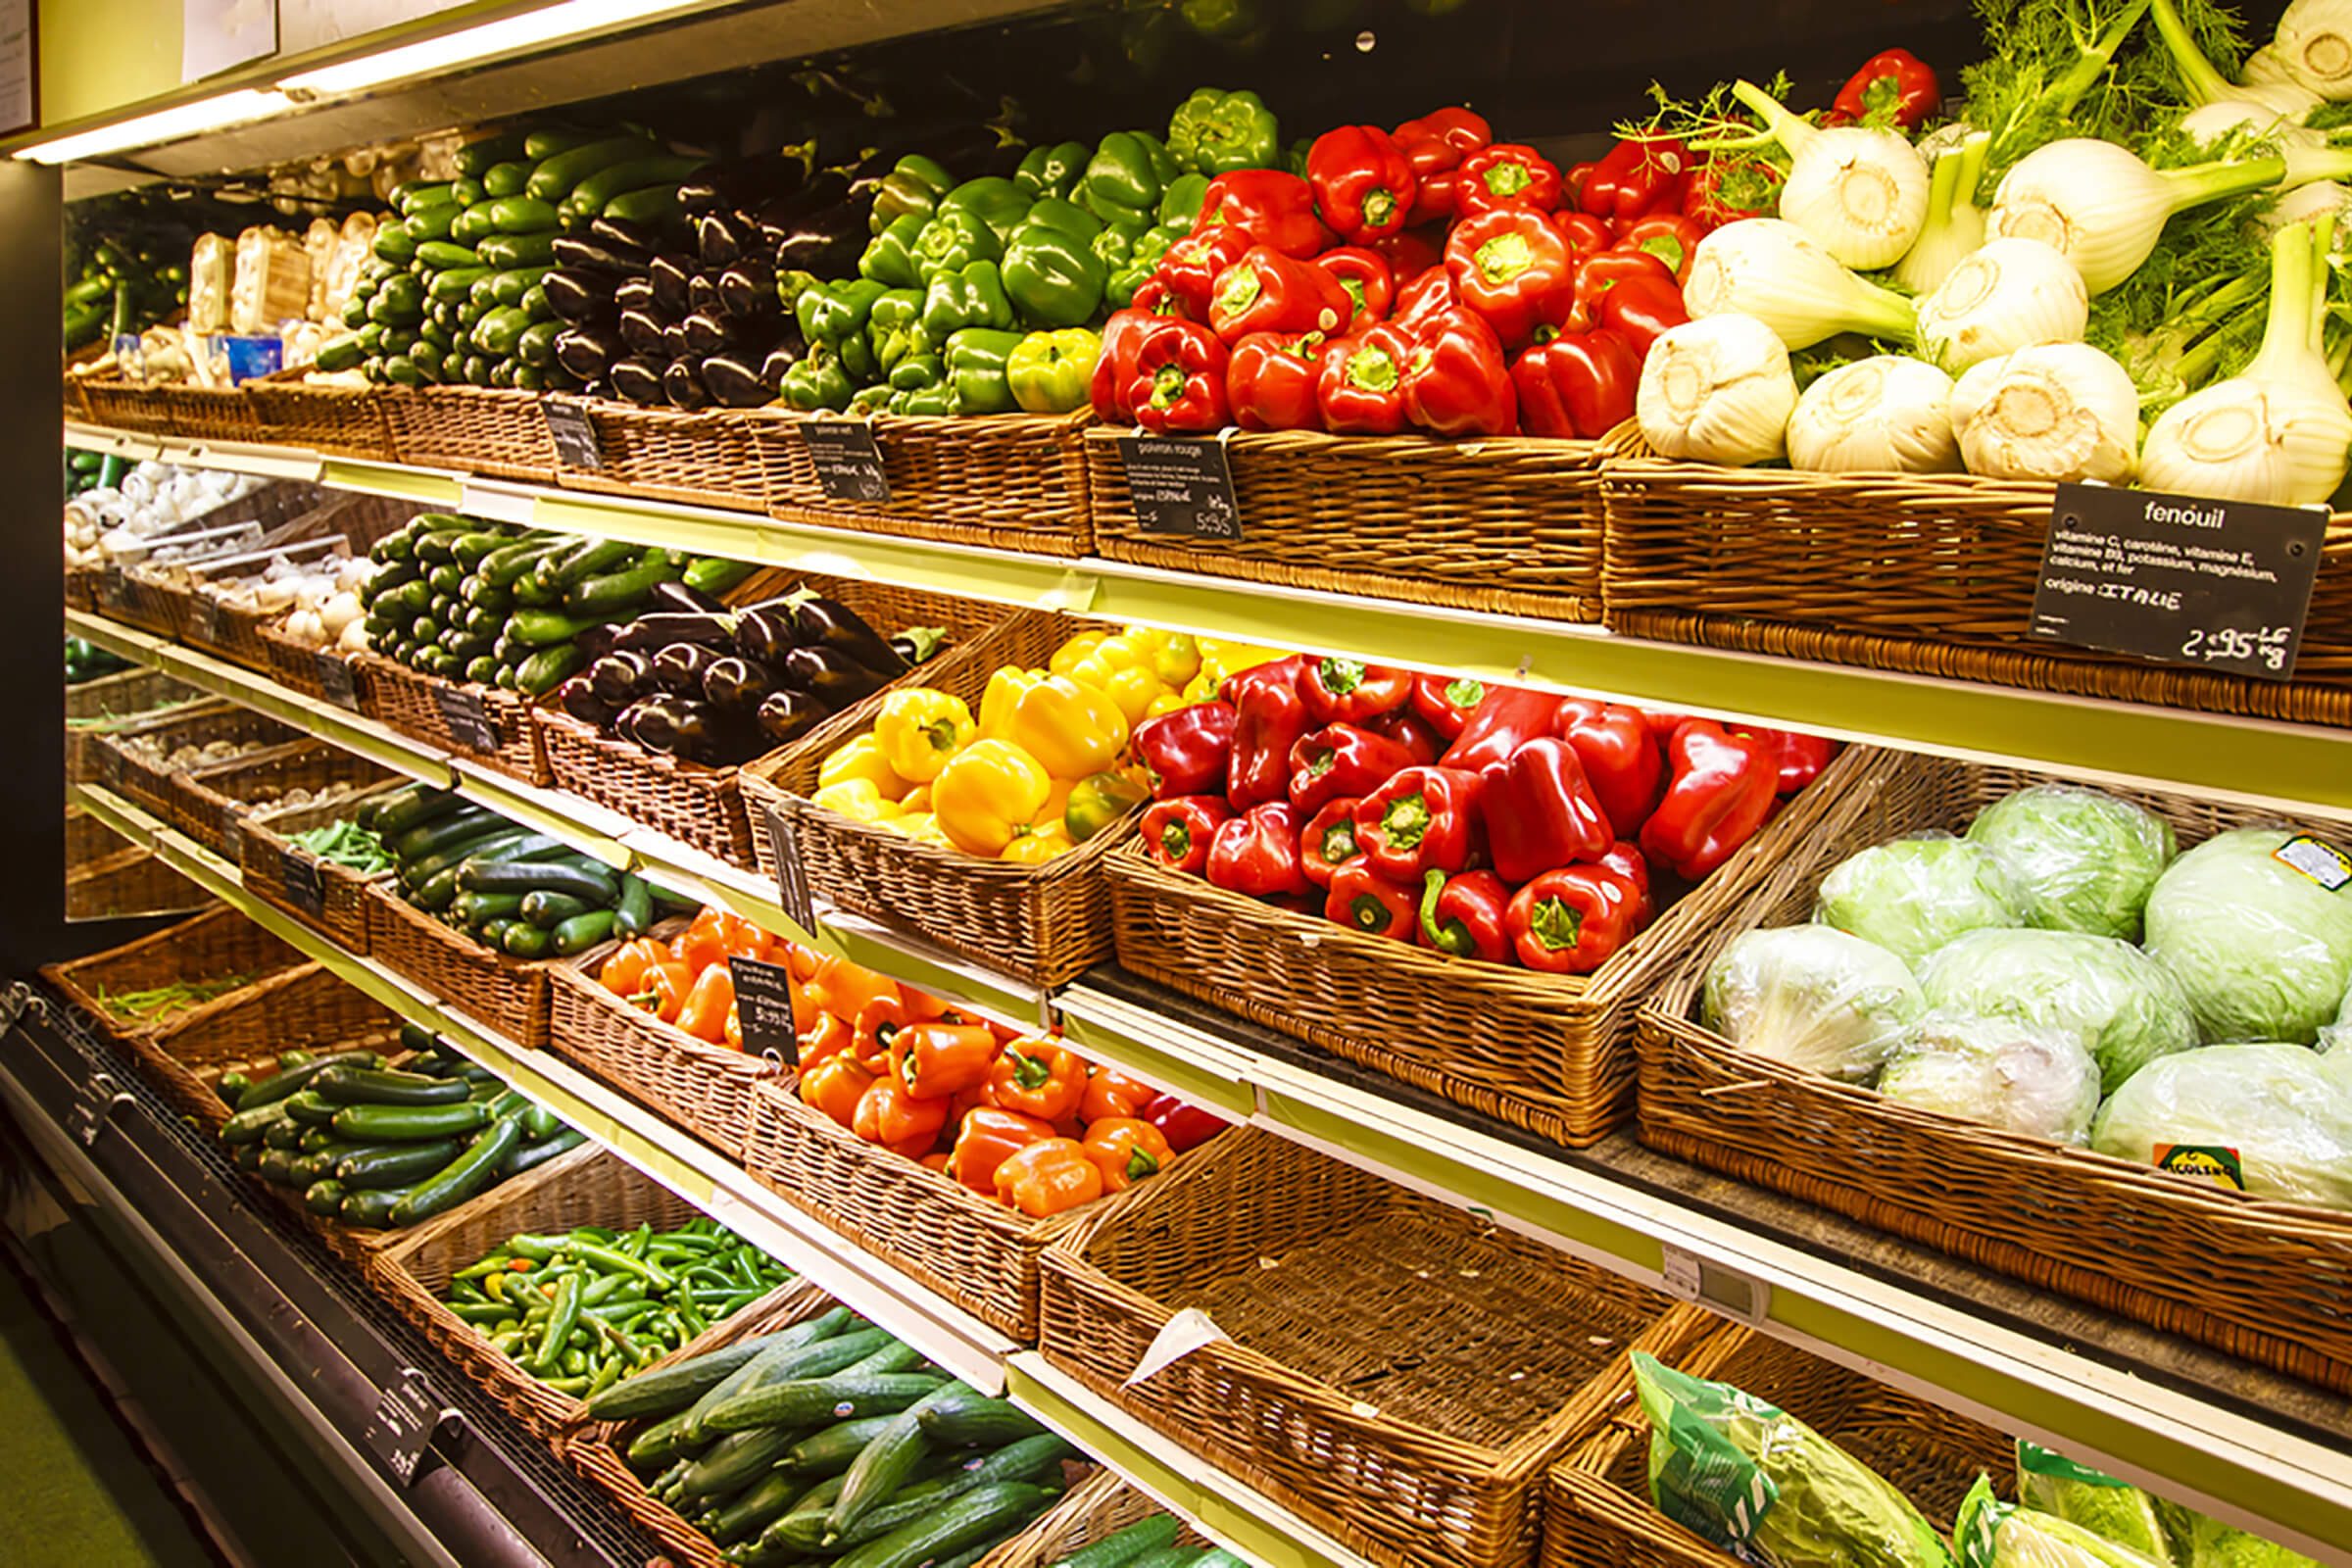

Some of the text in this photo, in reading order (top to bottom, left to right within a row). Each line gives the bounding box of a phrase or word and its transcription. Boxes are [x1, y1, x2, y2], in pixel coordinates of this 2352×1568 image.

[2143, 501, 2227, 529] fenouil
[2051, 541, 2103, 559] vitamine
[2127, 553, 2197, 572] potassium,
[2054, 529, 2106, 547] vitamine
[2183, 545, 2238, 564] vitamine
[2048, 554, 2099, 573] calcium,
[2044, 576, 2096, 596] origine
